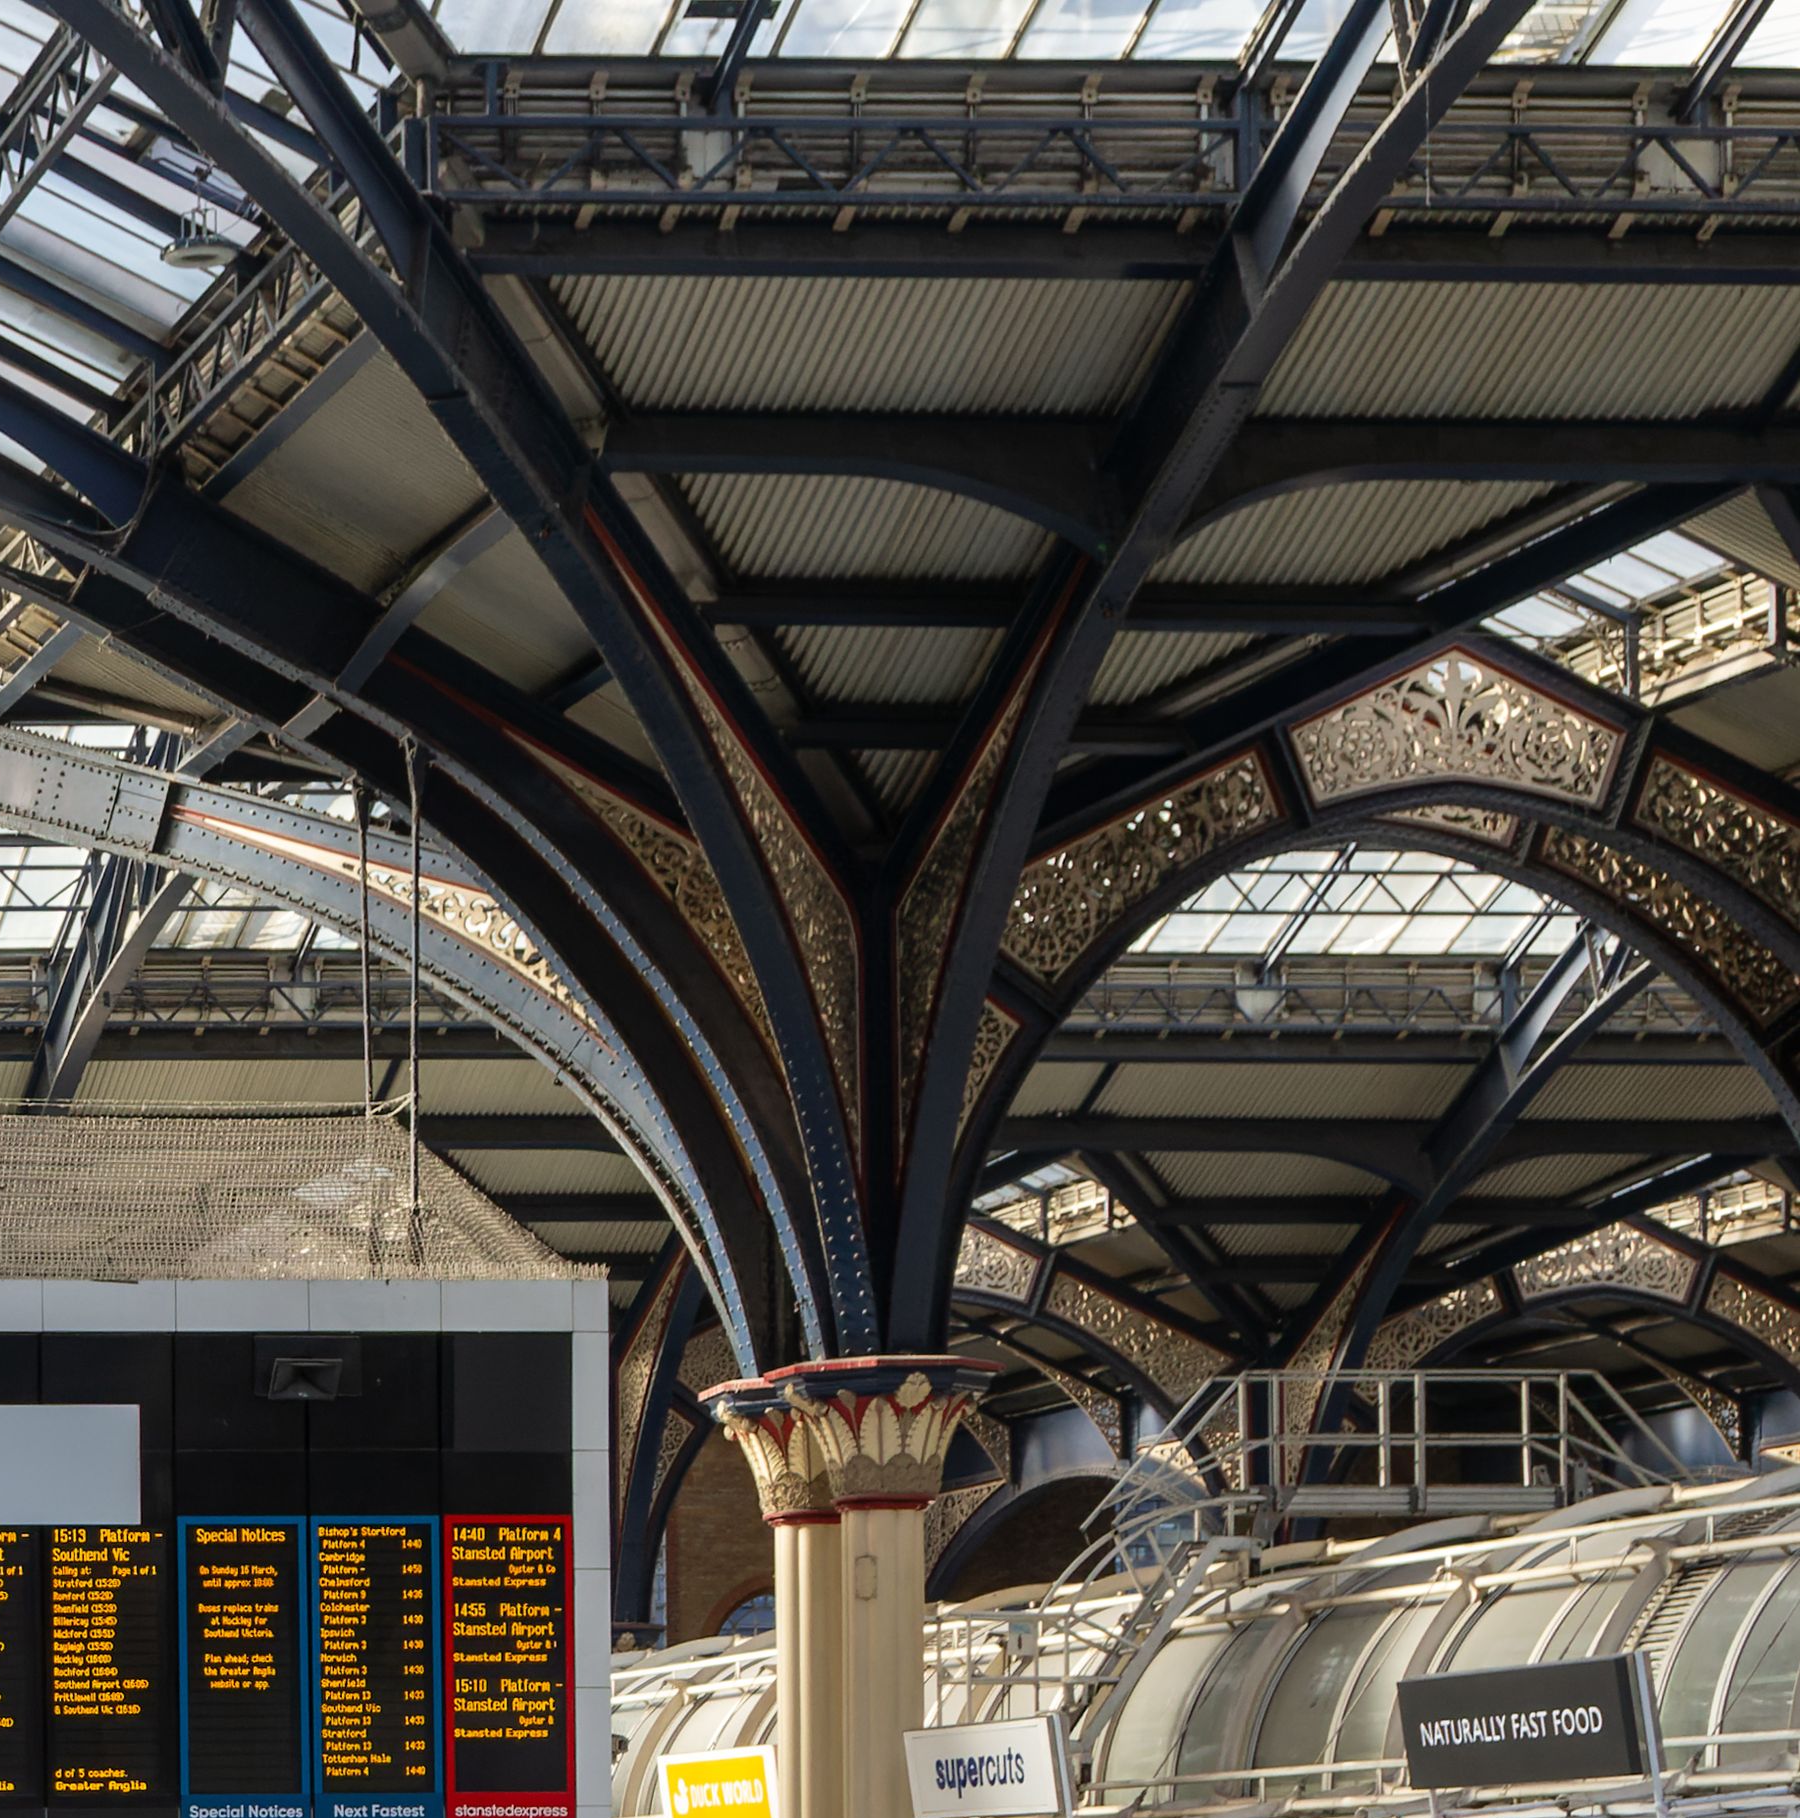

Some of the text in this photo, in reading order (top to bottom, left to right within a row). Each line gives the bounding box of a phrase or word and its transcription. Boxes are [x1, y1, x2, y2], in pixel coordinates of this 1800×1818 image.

[197, 1529, 286, 1543] Special Notices
[318, 1527, 406, 1537] Bishop's Stortford
[453, 1527, 562, 1542] 14:40 Platform 4
[452, 1546, 554, 1561] Stansted Airport
[1420, 1704, 1604, 1748] NATURALLY FAST FOOD
[935, 1746, 1026, 1799] supercuts
[690, 1777, 764, 1810] DUCK WORLD
[189, 1805, 303, 1818] Special Notices
[334, 1805, 425, 1818] Next Fastest
[455, 1805, 568, 1818] stanstedexpress
